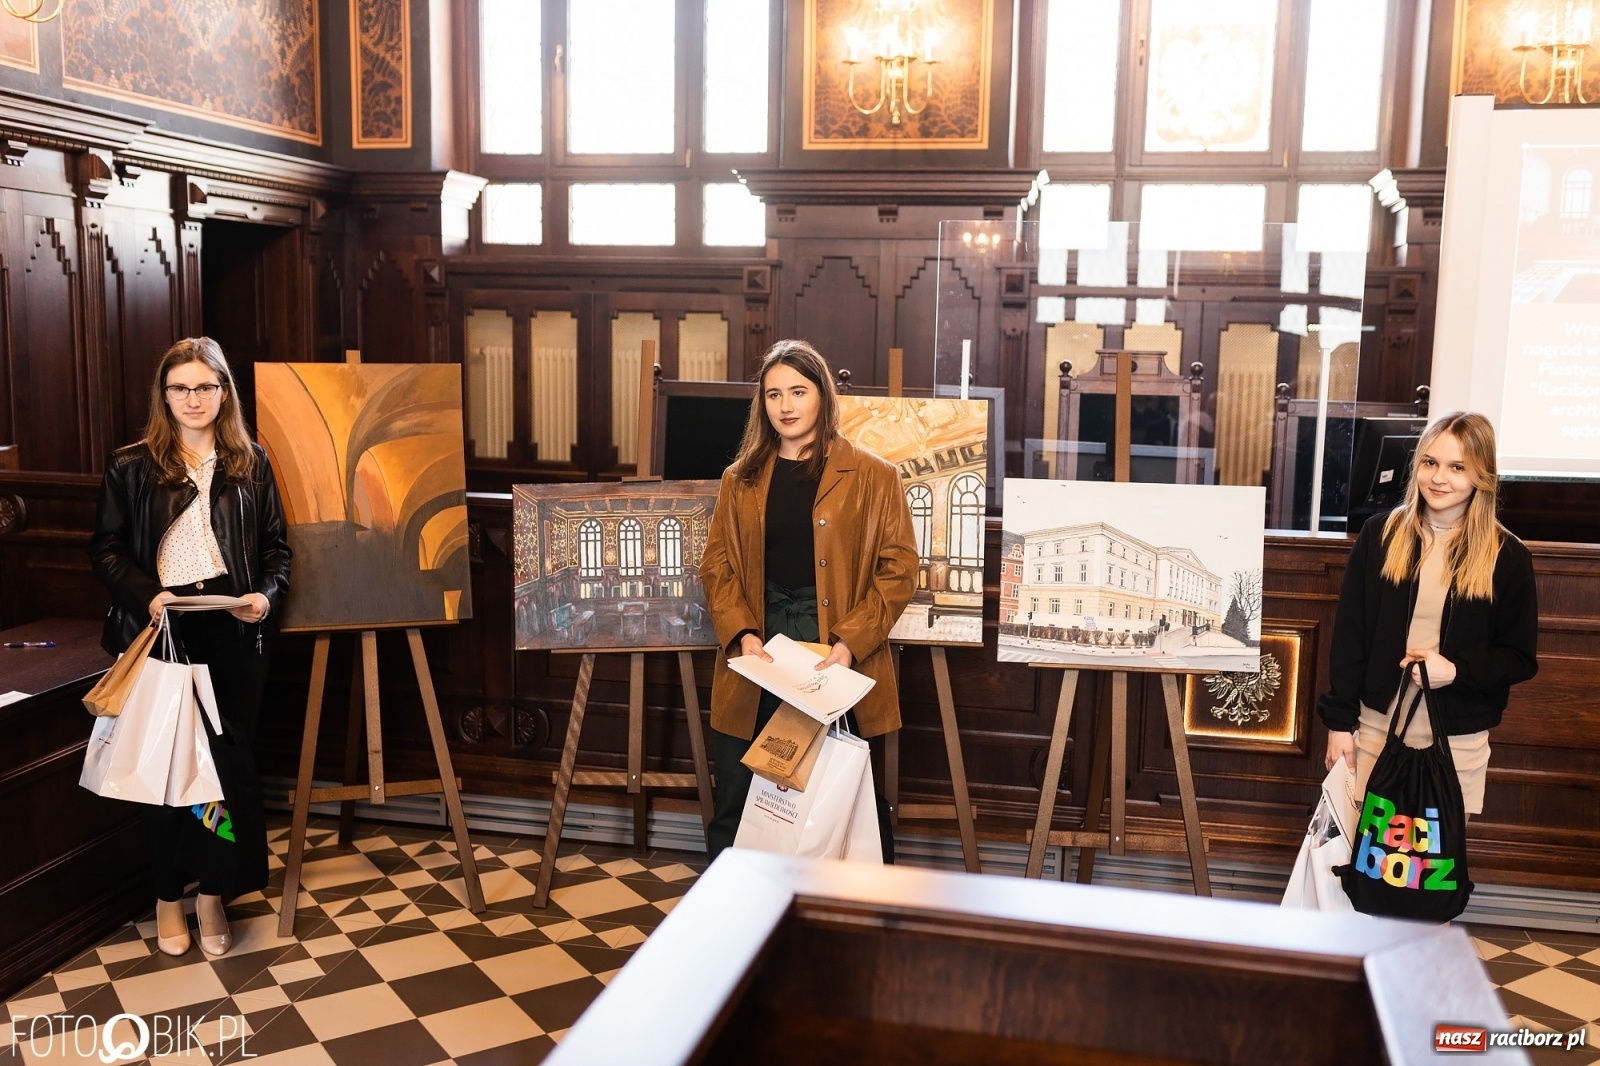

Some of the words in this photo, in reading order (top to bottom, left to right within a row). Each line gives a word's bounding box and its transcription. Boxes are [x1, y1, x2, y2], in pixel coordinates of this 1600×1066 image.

[1522, 341, 1584, 360] nagród
[1548, 403, 1600, 417] archit
[1358, 791, 1441, 854] Raci
